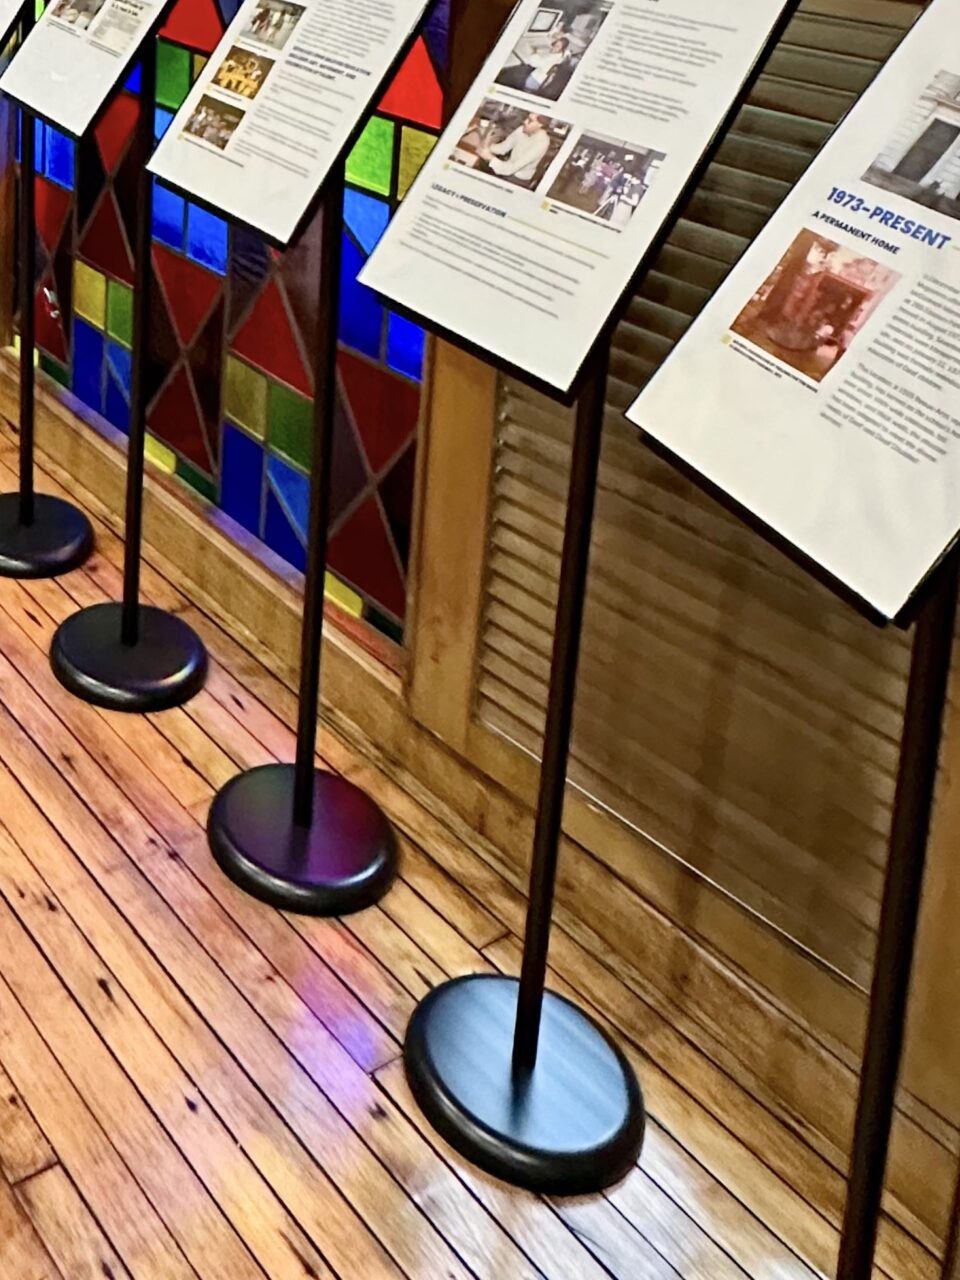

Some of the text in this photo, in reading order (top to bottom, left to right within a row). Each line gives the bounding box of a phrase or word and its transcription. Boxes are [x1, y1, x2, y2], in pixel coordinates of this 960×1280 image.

[812, 210, 900, 255] A PERMANENT HOME
[827, 186, 952, 250] 1973-PRESENT
